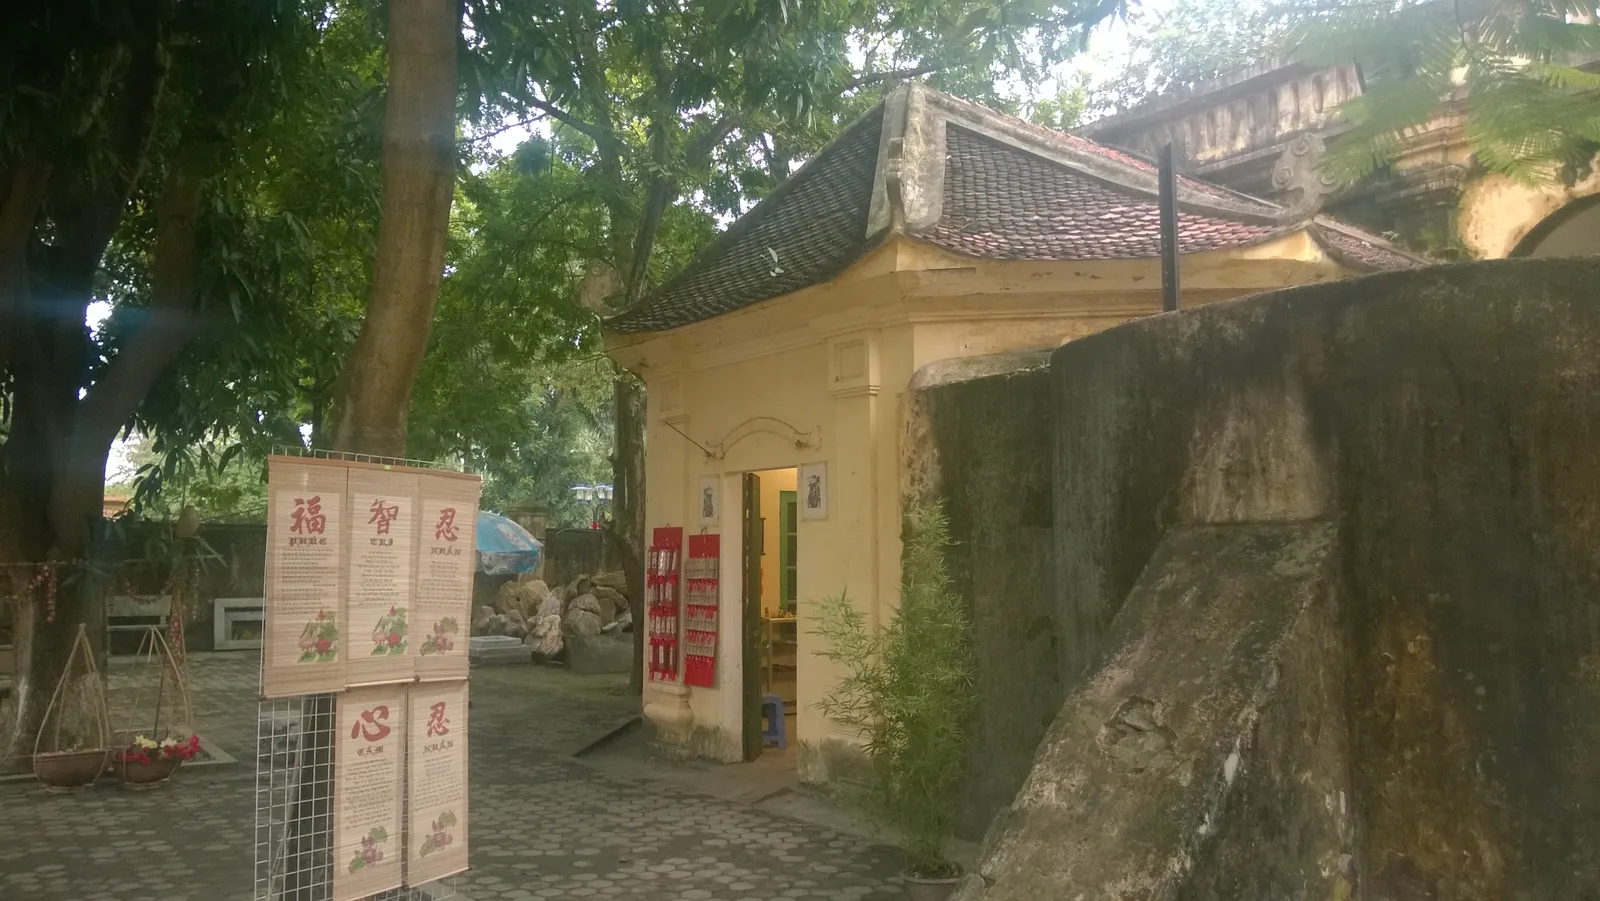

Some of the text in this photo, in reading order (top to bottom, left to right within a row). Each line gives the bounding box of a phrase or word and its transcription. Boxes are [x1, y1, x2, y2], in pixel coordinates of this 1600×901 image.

[290, 495, 326, 535] 福
[368, 499, 399, 535] 智
[435, 507, 459, 541] 忍
[350, 705, 391, 742] 心
[427, 701, 450, 738] 忍
